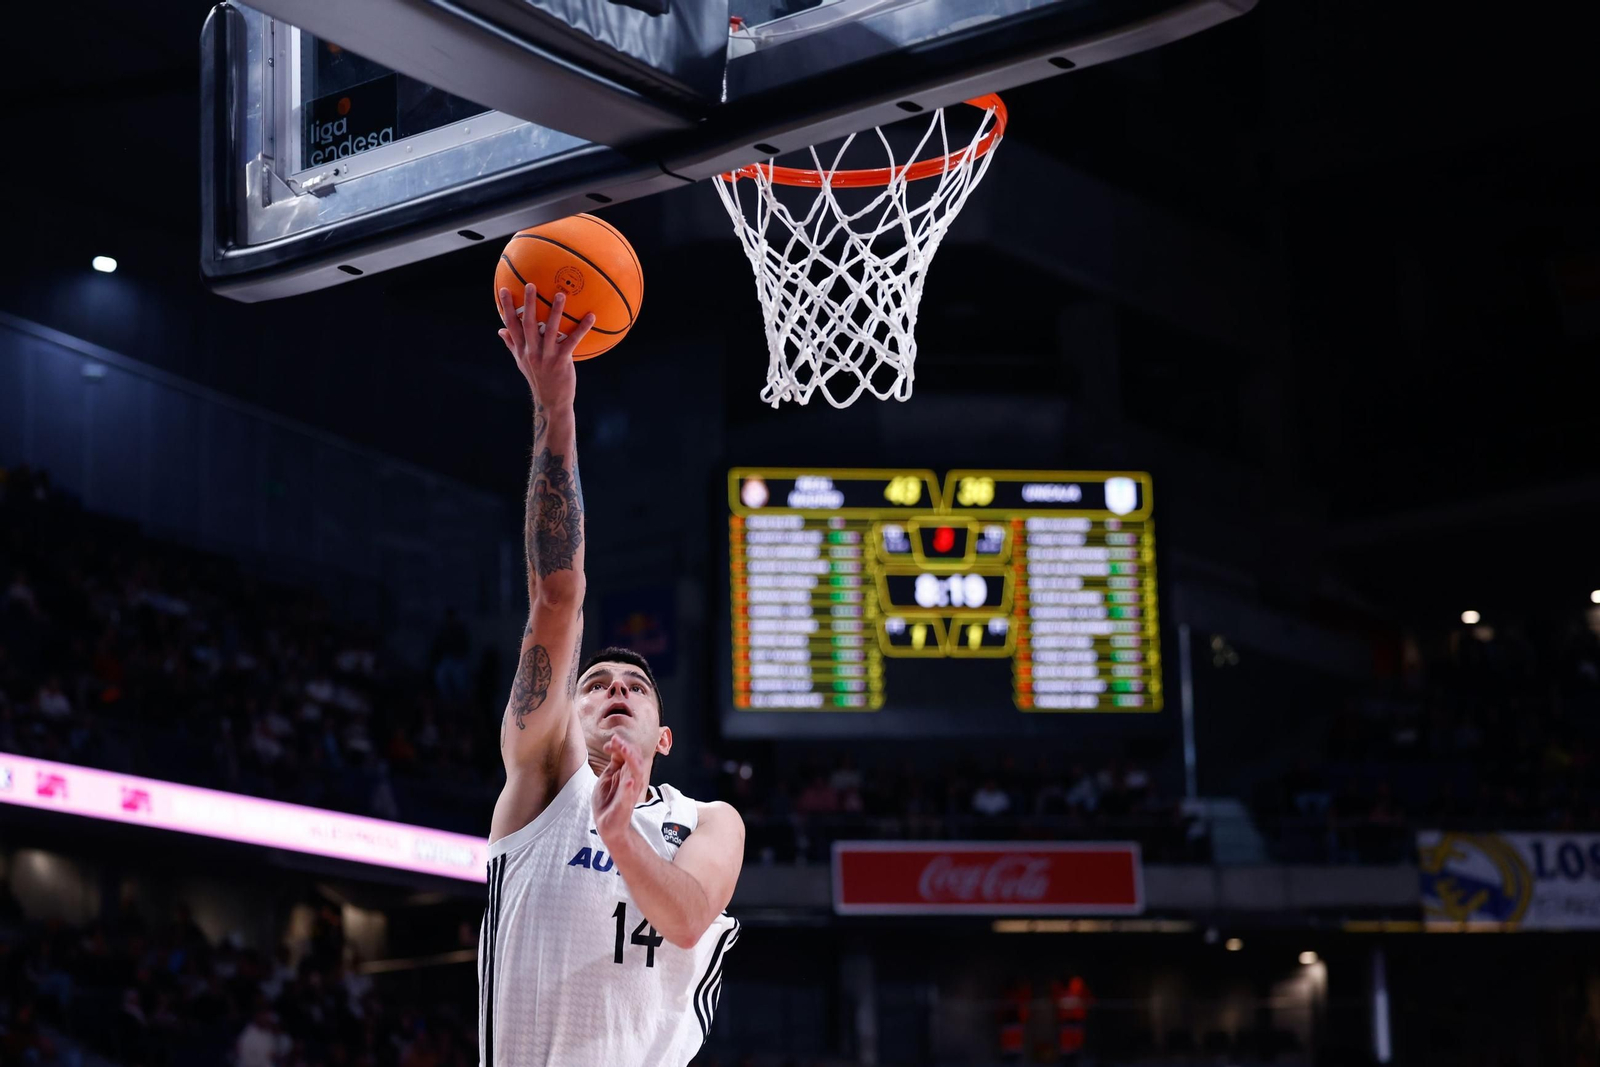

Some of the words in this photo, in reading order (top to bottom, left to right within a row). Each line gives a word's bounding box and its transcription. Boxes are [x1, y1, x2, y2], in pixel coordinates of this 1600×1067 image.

[310, 117, 347, 144] liga
[310, 126, 393, 167] endesa
[567, 846, 621, 876] AU
[612, 901, 664, 968] 14
